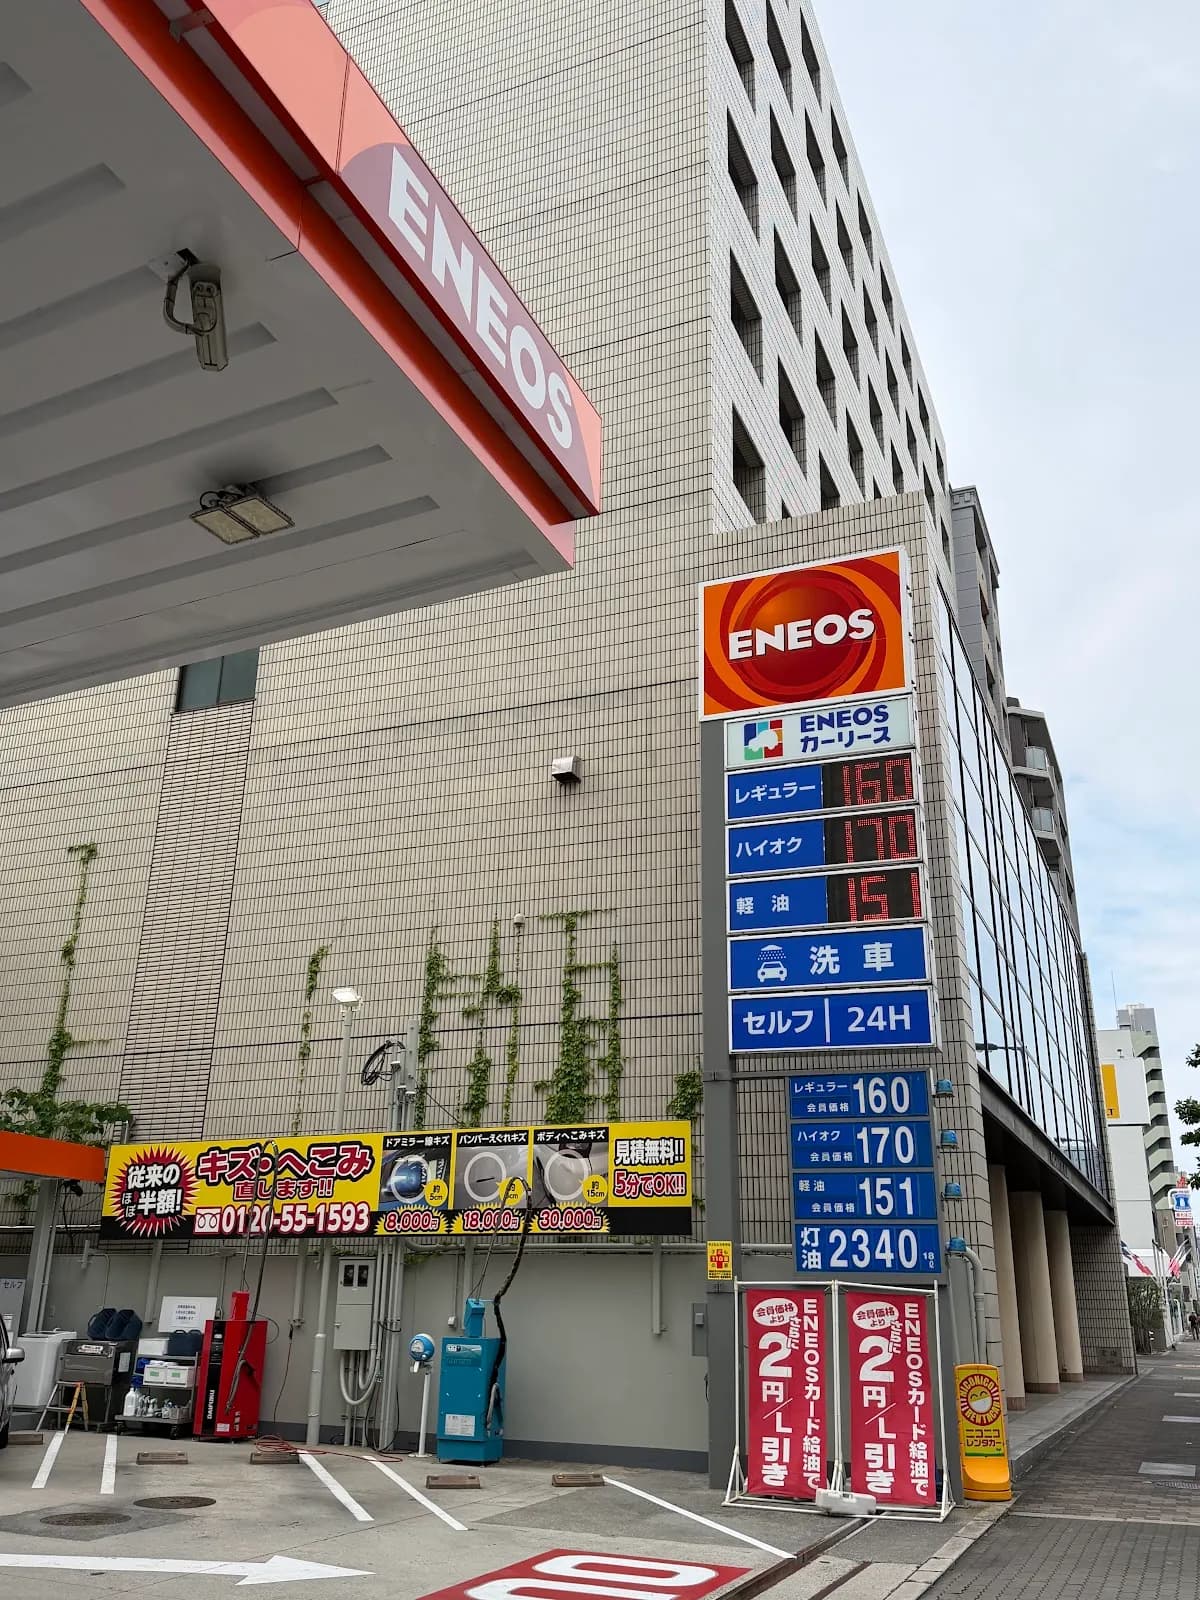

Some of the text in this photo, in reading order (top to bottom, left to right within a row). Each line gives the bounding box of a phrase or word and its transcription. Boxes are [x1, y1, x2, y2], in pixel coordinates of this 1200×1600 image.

[388, 146, 572, 448] ENEOS
[728, 608, 875, 660] ENEOS
[800, 704, 889, 732] ENEOS
[800, 727, 891, 753] カーリース
[735, 781, 816, 804] レギュラー
[842, 758, 912, 807] 160
[736, 836, 802, 858] ハイオク
[844, 814, 918, 864] 170
[847, 872, 922, 923] 151
[809, 941, 894, 975] 洗車
[743, 1004, 911, 1035] セルフ 24H
[794, 1081, 848, 1094] レギュラー
[853, 1076, 910, 1114] 160
[806, 1102, 849, 1113] 会員価格
[459, 1132, 528, 1145] バンパーえぐれキズ
[537, 1130, 606, 1142] ボディへこみキズ
[797, 1130, 841, 1142] ハイオク
[856, 1125, 915, 1164] 170
[198, 1144, 372, 1183] キズ・へこみ
[615, 1138, 684, 1165] 見積無料!!
[810, 1151, 853, 1162] 会員価格
[127, 1164, 181, 1190] 従来の
[614, 1170, 686, 1198] 5分でOK!!
[799, 1180, 825, 1192] 軽油
[122, 1192, 137, 1218] ほぼ
[586, 1189, 605, 1198] 15cm
[859, 1176, 914, 1216] 151
[222, 1201, 370, 1234] 0120-55-1593
[811, 1203, 855, 1213] 会員価格
[800, 1227, 822, 1270] 灯油
[828, 1228, 918, 1269] 2340
[756, 1302, 794, 1318] 会員価格
[769, 1314, 785, 1324] より
[856, 1306, 895, 1321] 会員価格
[870, 1318, 886, 1328] より
[960, 1375, 995, 1397] NICONICO
[904, 1302, 929, 1497] ENEOSカード給油で
[966, 1429, 1000, 1439] ニコニコ
[966, 1439, 1002, 1447] レンタカー
